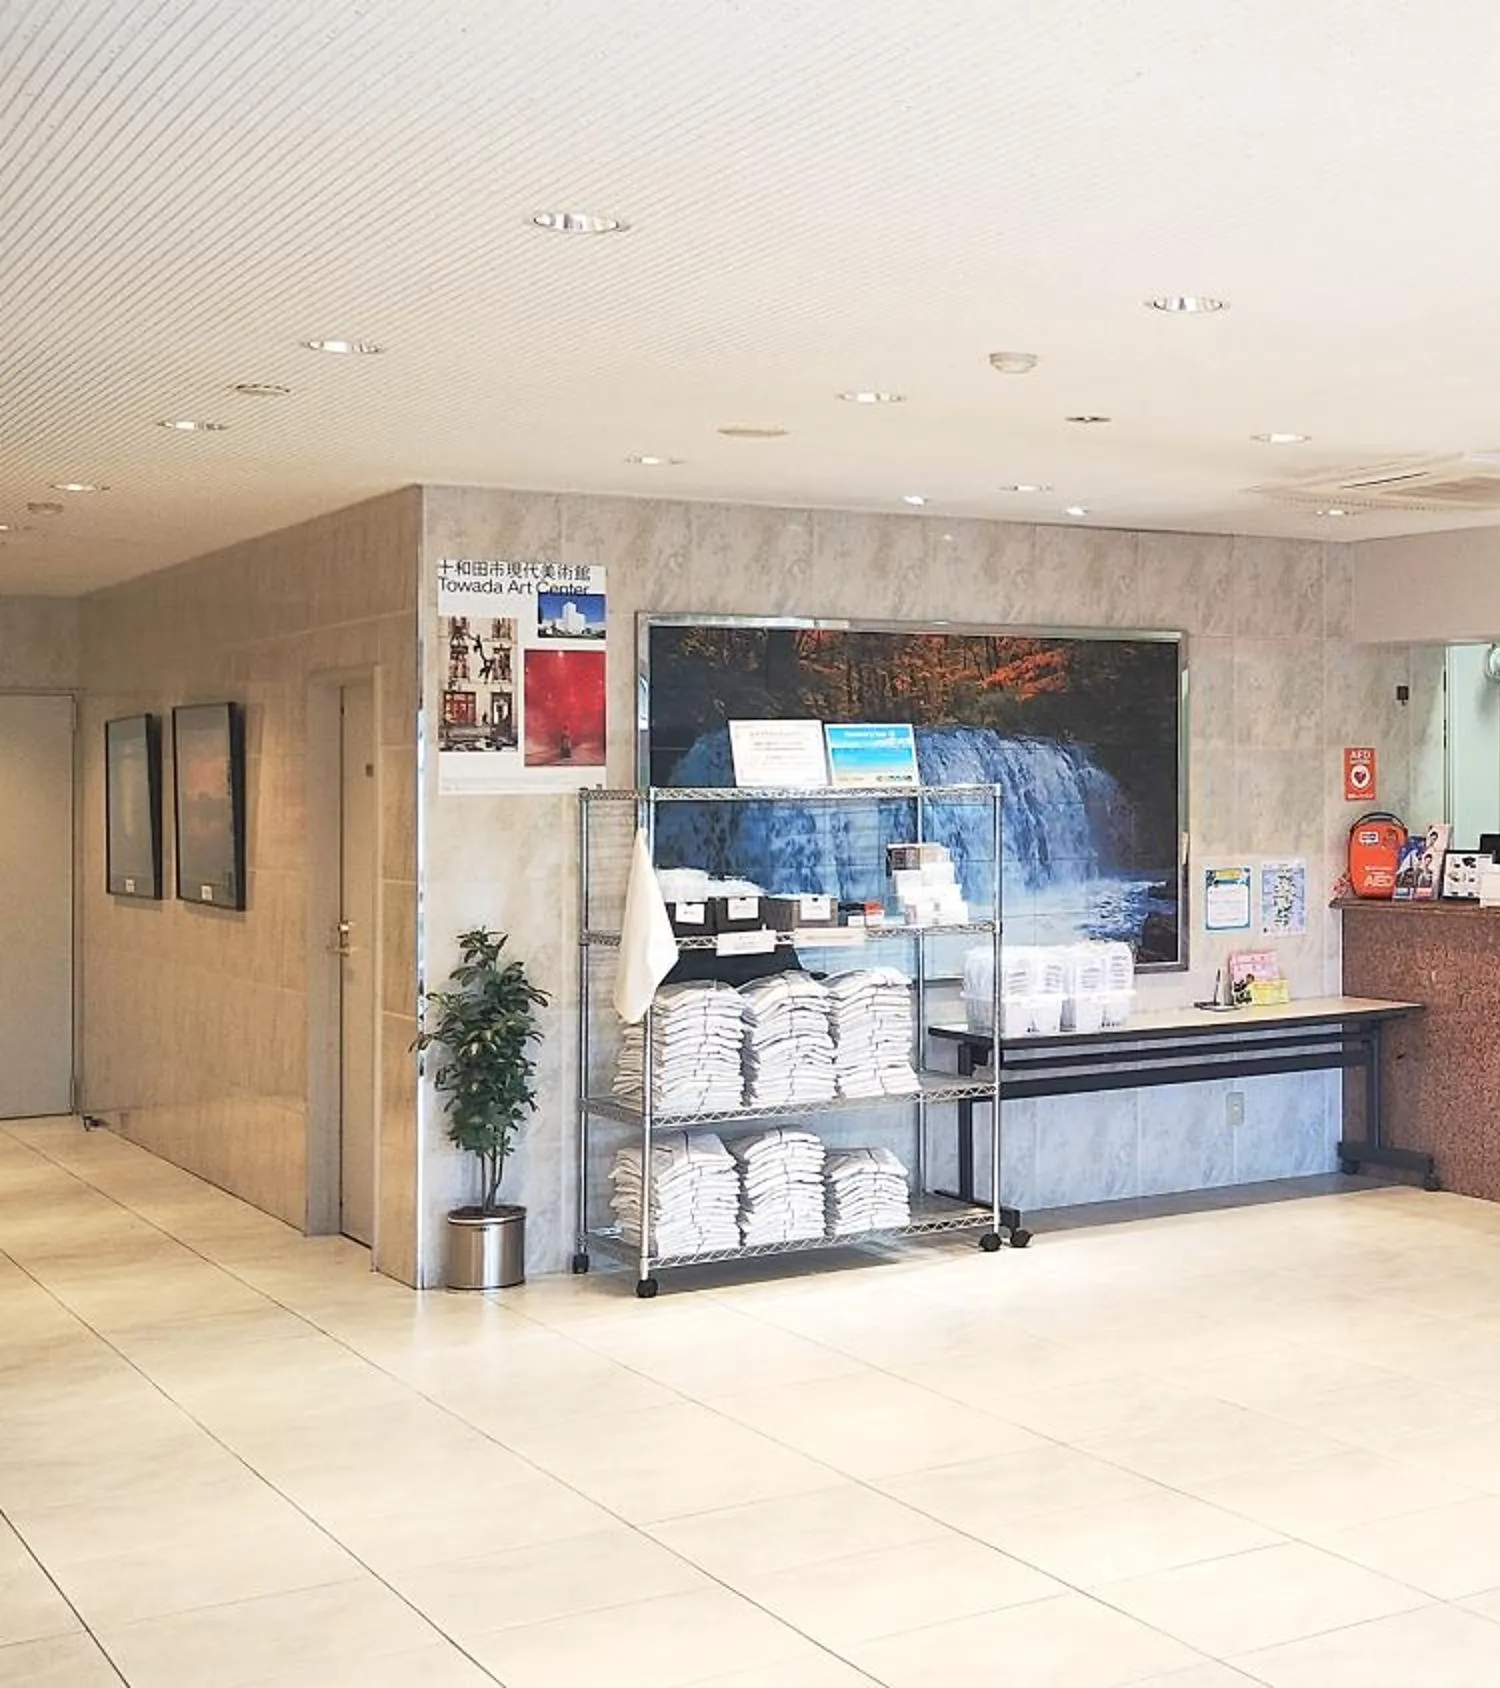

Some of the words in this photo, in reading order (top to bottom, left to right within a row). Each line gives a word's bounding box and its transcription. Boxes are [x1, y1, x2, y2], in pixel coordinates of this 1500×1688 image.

[438, 576, 503, 594] Towada
[507, 580, 532, 594] Art
[536, 582, 590, 595] Center
[1350, 750, 1371, 760] AED
